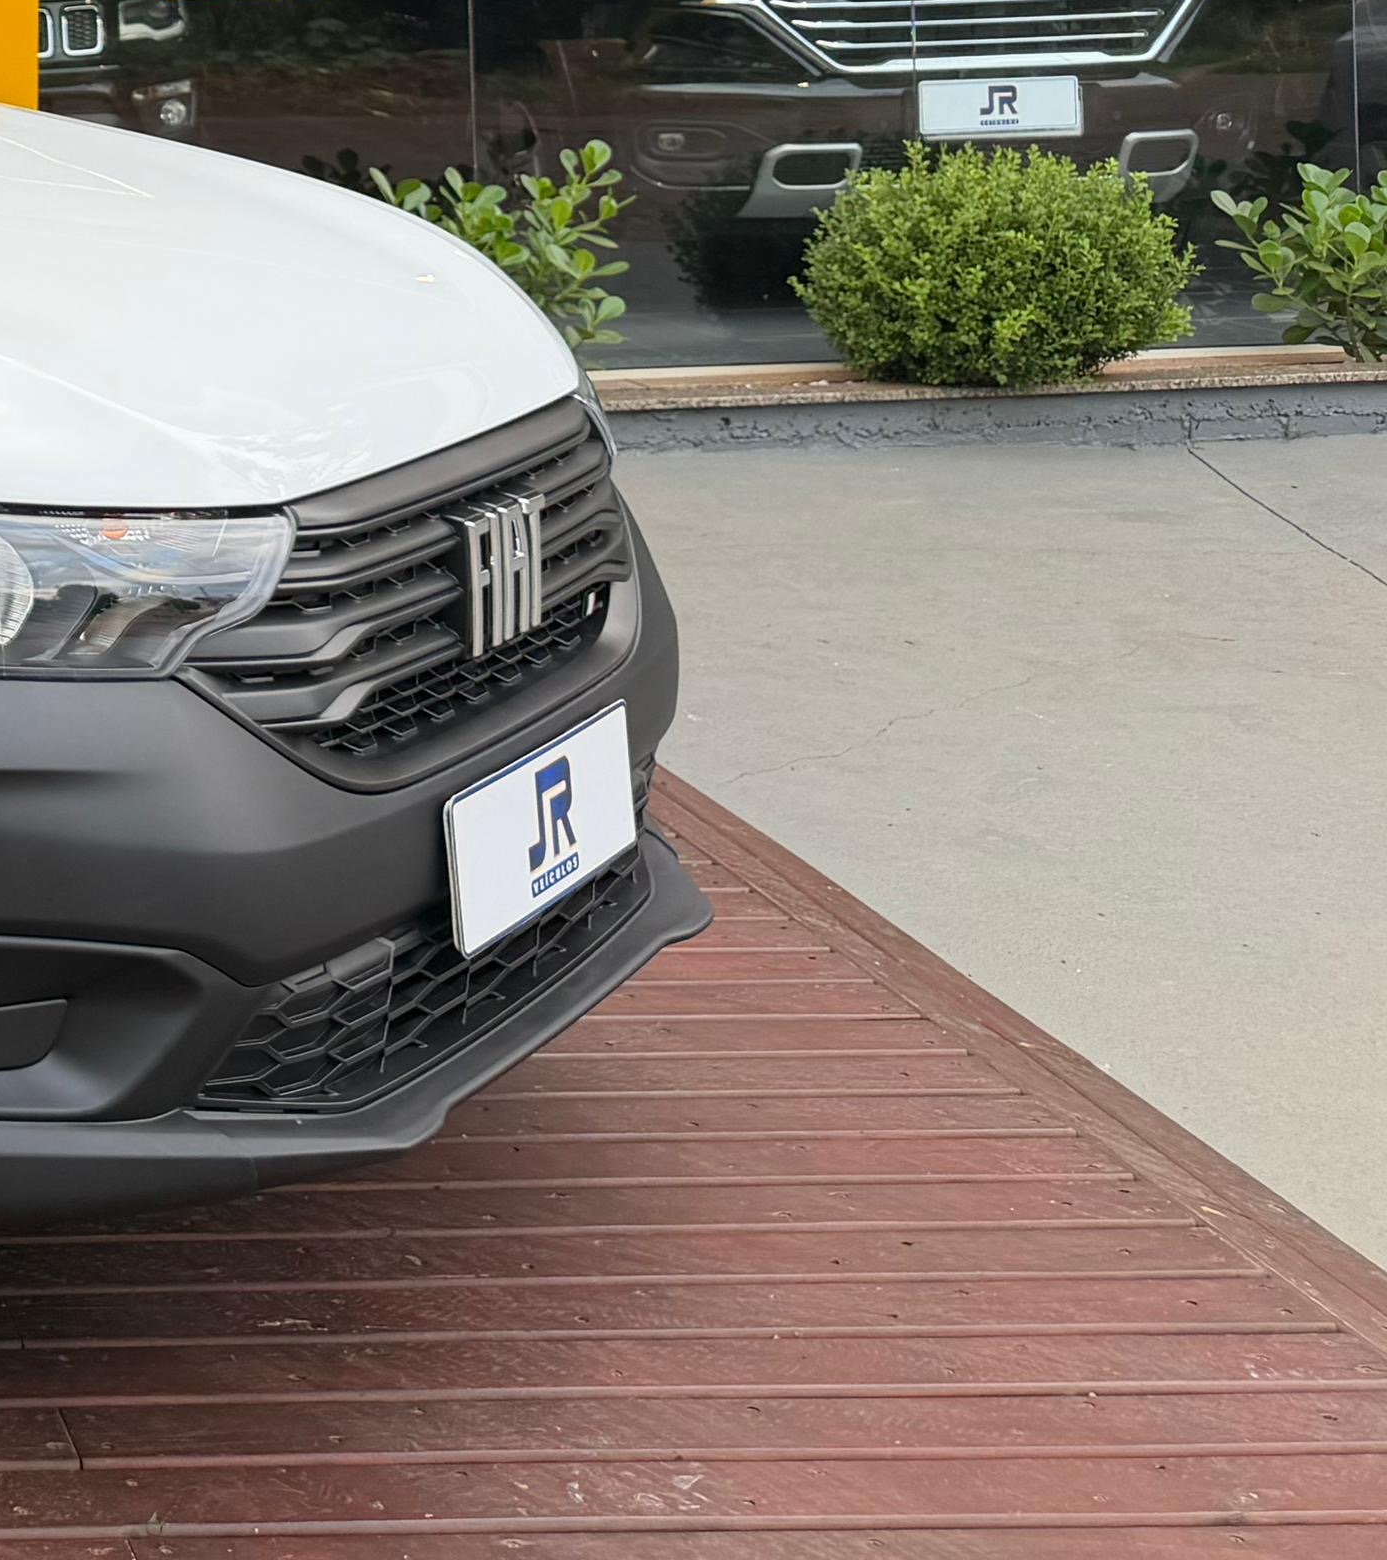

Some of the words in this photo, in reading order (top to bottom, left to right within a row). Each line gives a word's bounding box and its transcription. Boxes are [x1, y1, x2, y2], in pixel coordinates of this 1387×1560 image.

[980, 85, 1018, 116] JR
[465, 493, 545, 658] FIAT
[529, 755, 577, 873] JR
